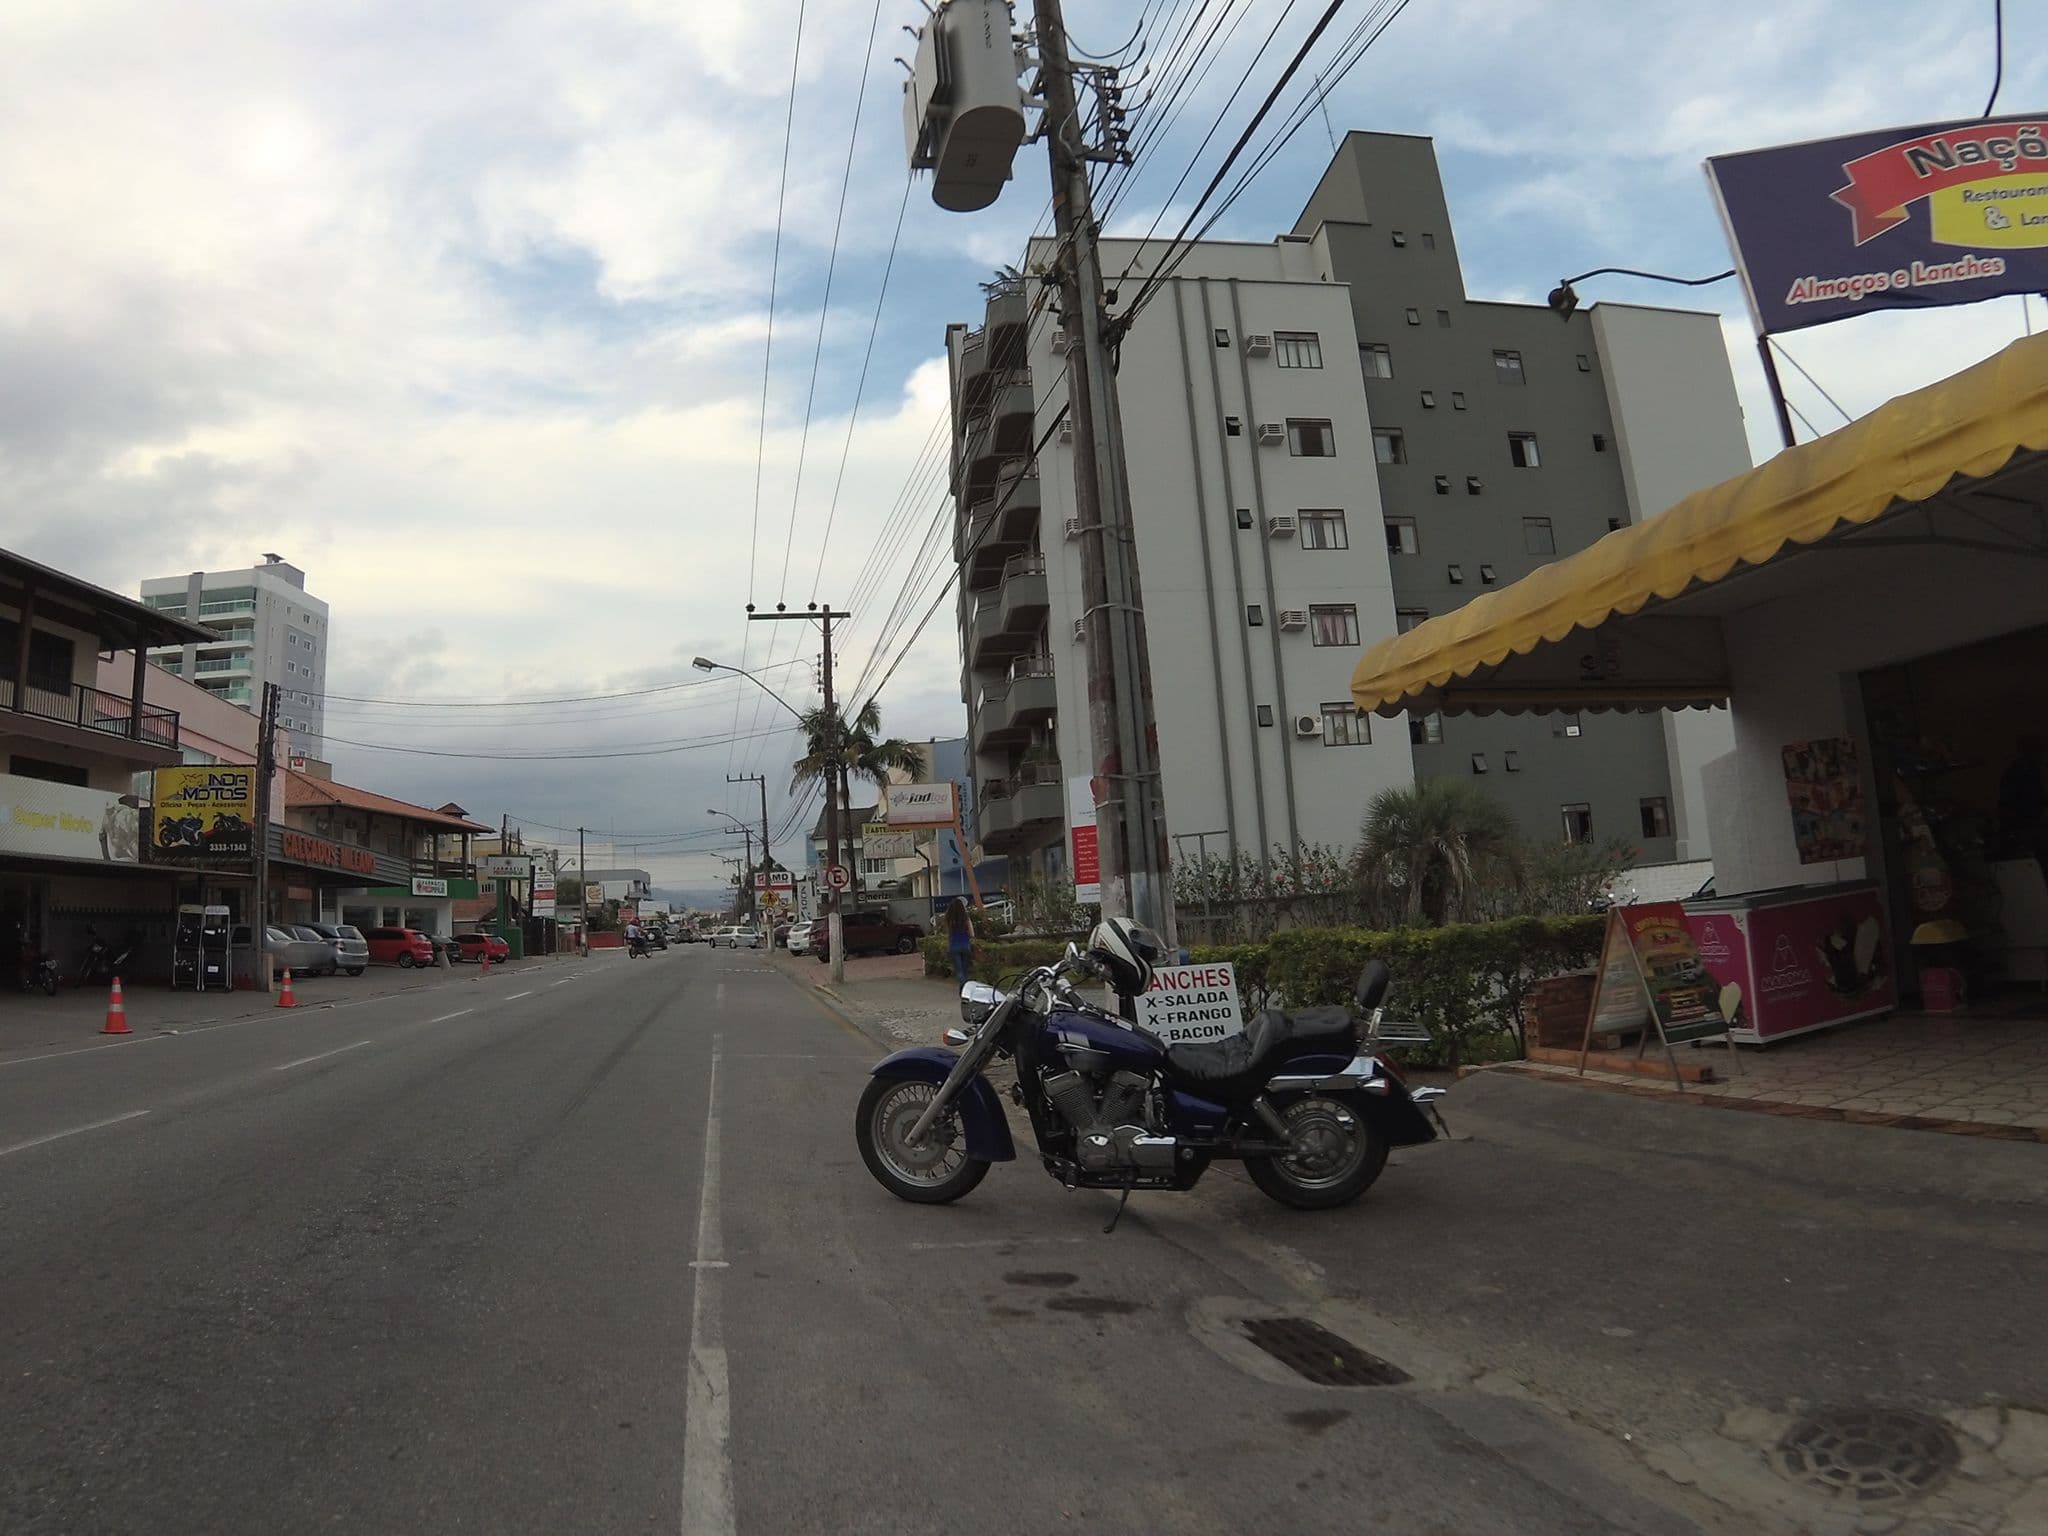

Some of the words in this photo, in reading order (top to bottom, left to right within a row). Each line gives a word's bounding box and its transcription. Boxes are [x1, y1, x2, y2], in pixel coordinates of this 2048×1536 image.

[1984, 206, 2011, 231] &
[1787, 271, 1888, 306] Almoços
[1892, 268, 1909, 291] e
[1912, 254, 2007, 287] Lanches
[182, 788, 248, 801] MOTOS
[833, 869, 842, 884] E
[1145, 968, 1230, 992] ANCHES
[1146, 991, 1229, 1008] X-SALADA
[1147, 1007, 1232, 1025] X-FRANGO
[1155, 1025, 1225, 1041] -BACON
